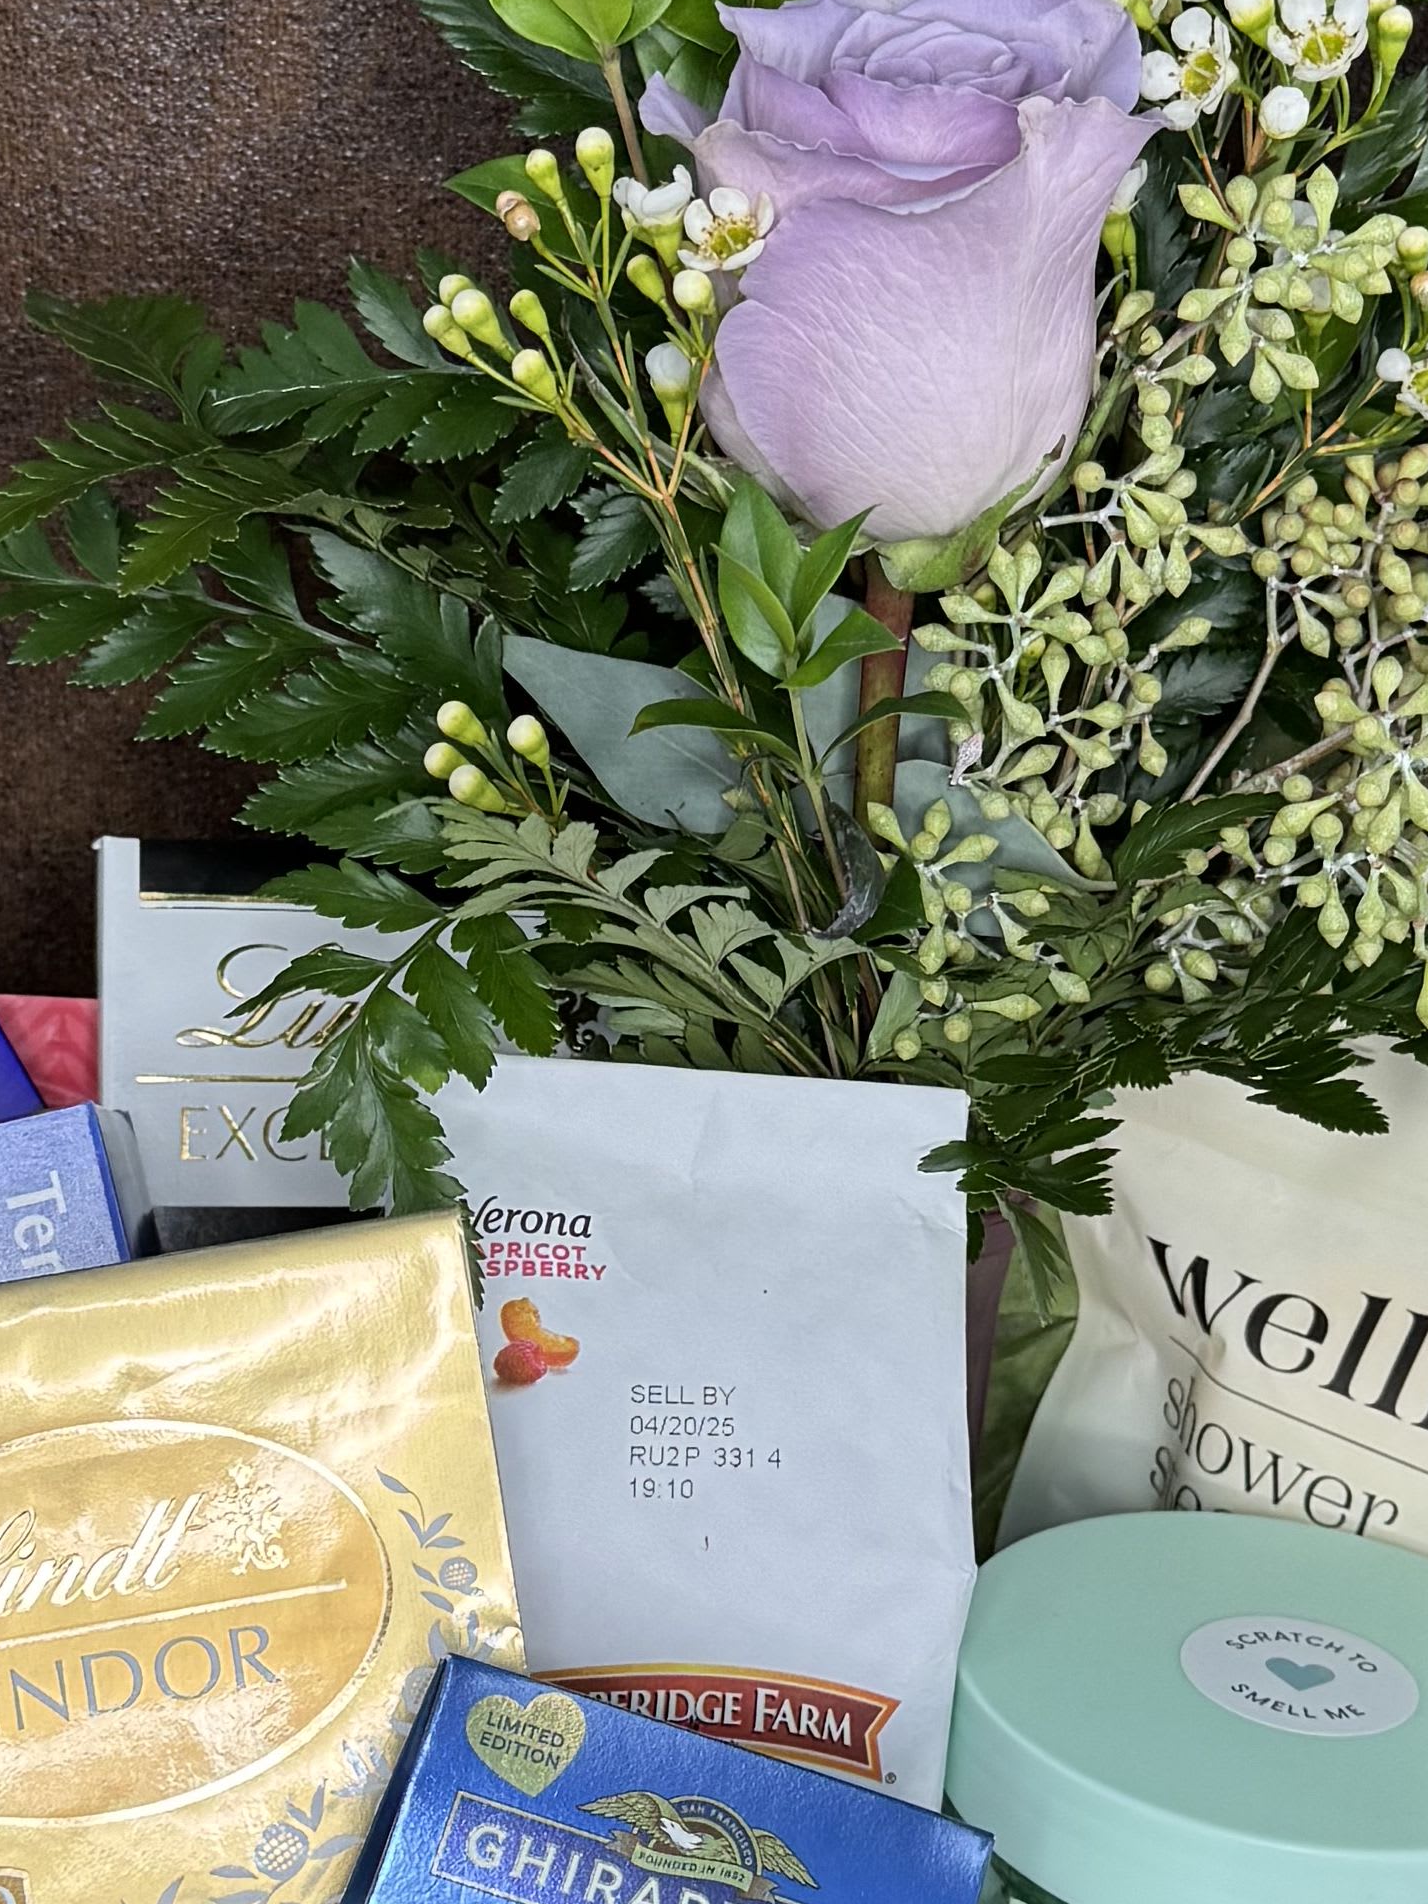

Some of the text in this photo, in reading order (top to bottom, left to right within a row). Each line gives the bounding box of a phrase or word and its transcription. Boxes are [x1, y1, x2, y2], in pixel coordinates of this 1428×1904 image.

[474, 1242, 586, 1262] PRICOT
[630, 1384, 736, 1406] SELL BY
[630, 1415, 735, 1437] 04/20/25
[1163, 1376, 1399, 1536] shower
[630, 1477, 694, 1499] 19:10
[1225, 1630, 1378, 1673] SCRATCH TO
[752, 1687, 853, 1748] FARM
[1230, 1683, 1366, 1720] SMELL ME
[486, 1711, 565, 1748] LIMITED
[478, 1731, 561, 1770] EDITION
[680, 1802, 753, 1867] SAN FRANCISCO
[637, 1851, 698, 1872] FOUNDED
